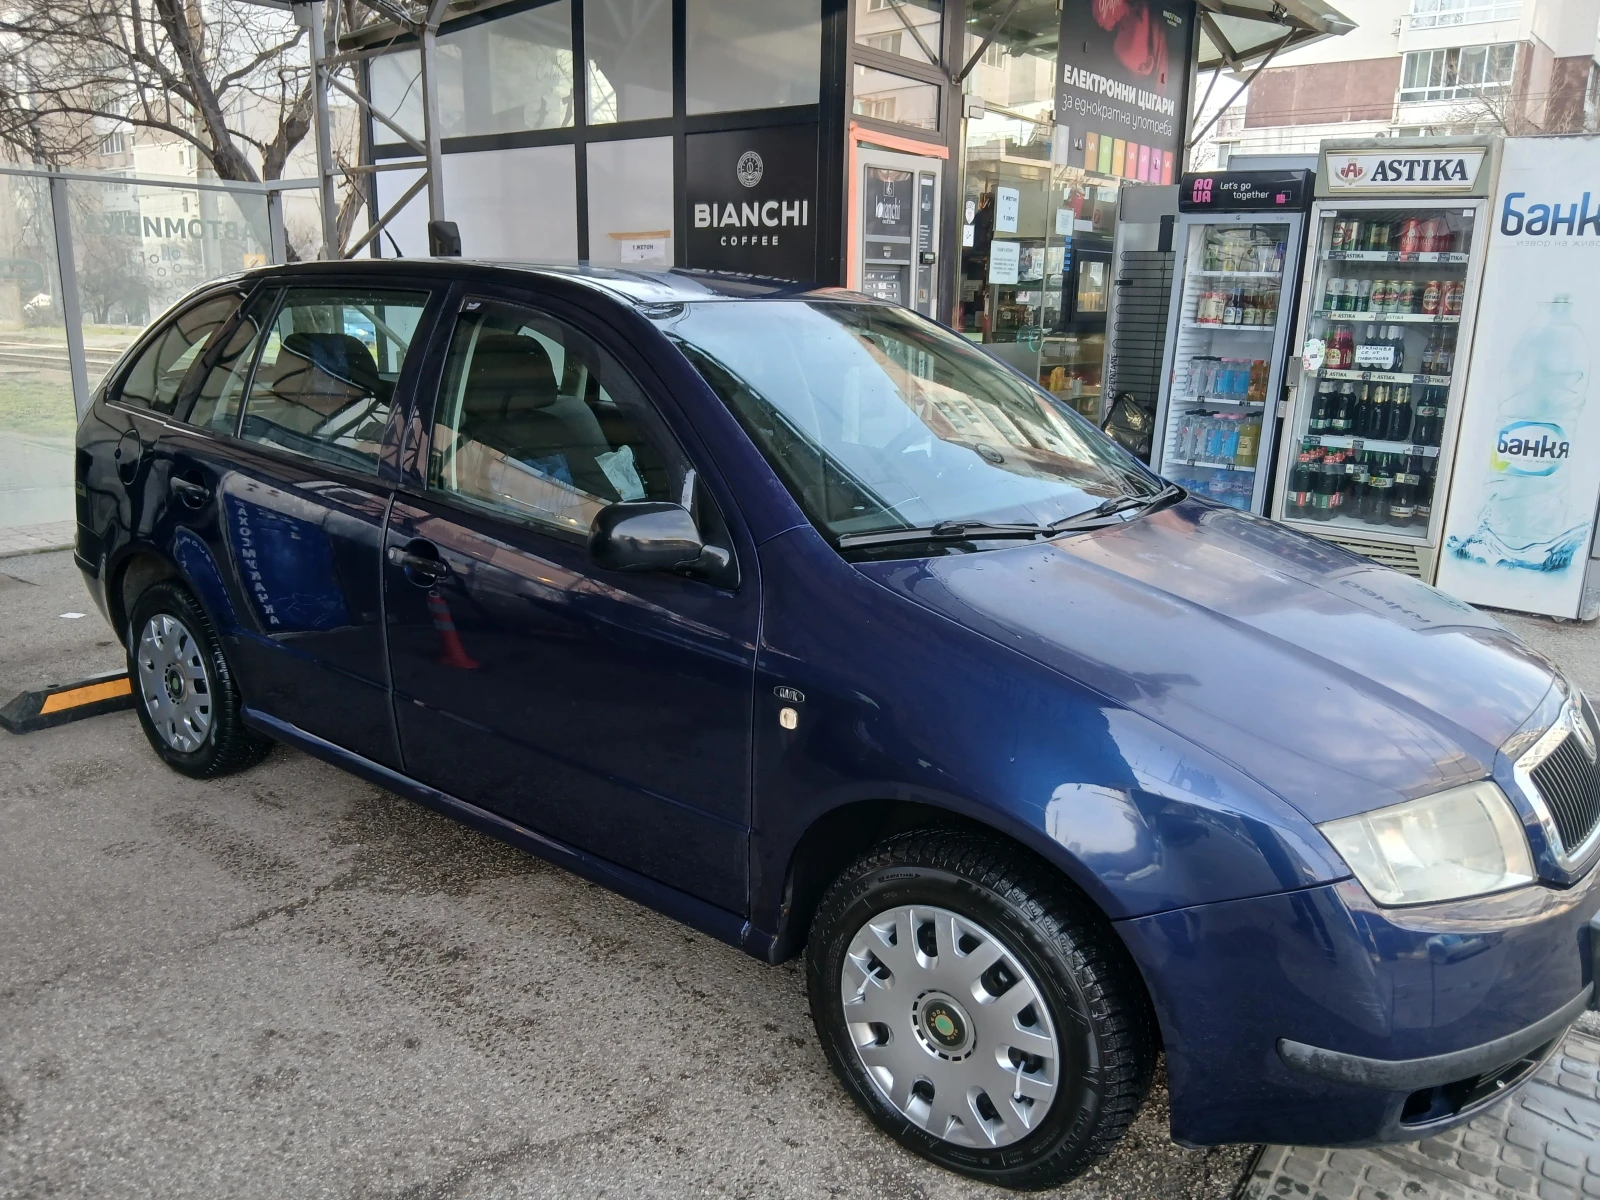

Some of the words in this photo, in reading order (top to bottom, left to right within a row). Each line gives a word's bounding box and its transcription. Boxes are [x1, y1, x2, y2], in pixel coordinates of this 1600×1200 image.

[1063, 64, 1137, 105] ЕЛЕКТРОННИ
[1138, 90, 1175, 116] ЦИГАРИ
[1062, 93, 1073, 111] за
[1075, 97, 1131, 125] еднократна
[1132, 115, 1172, 137] употреба
[1370, 158, 1468, 182] ASTIKA
[1220, 182, 1238, 190] Let's
[1240, 183, 1251, 191] go
[1233, 190, 1270, 199] together
[694, 200, 808, 228] BIANCHI
[720, 235, 779, 246] COFFEE
